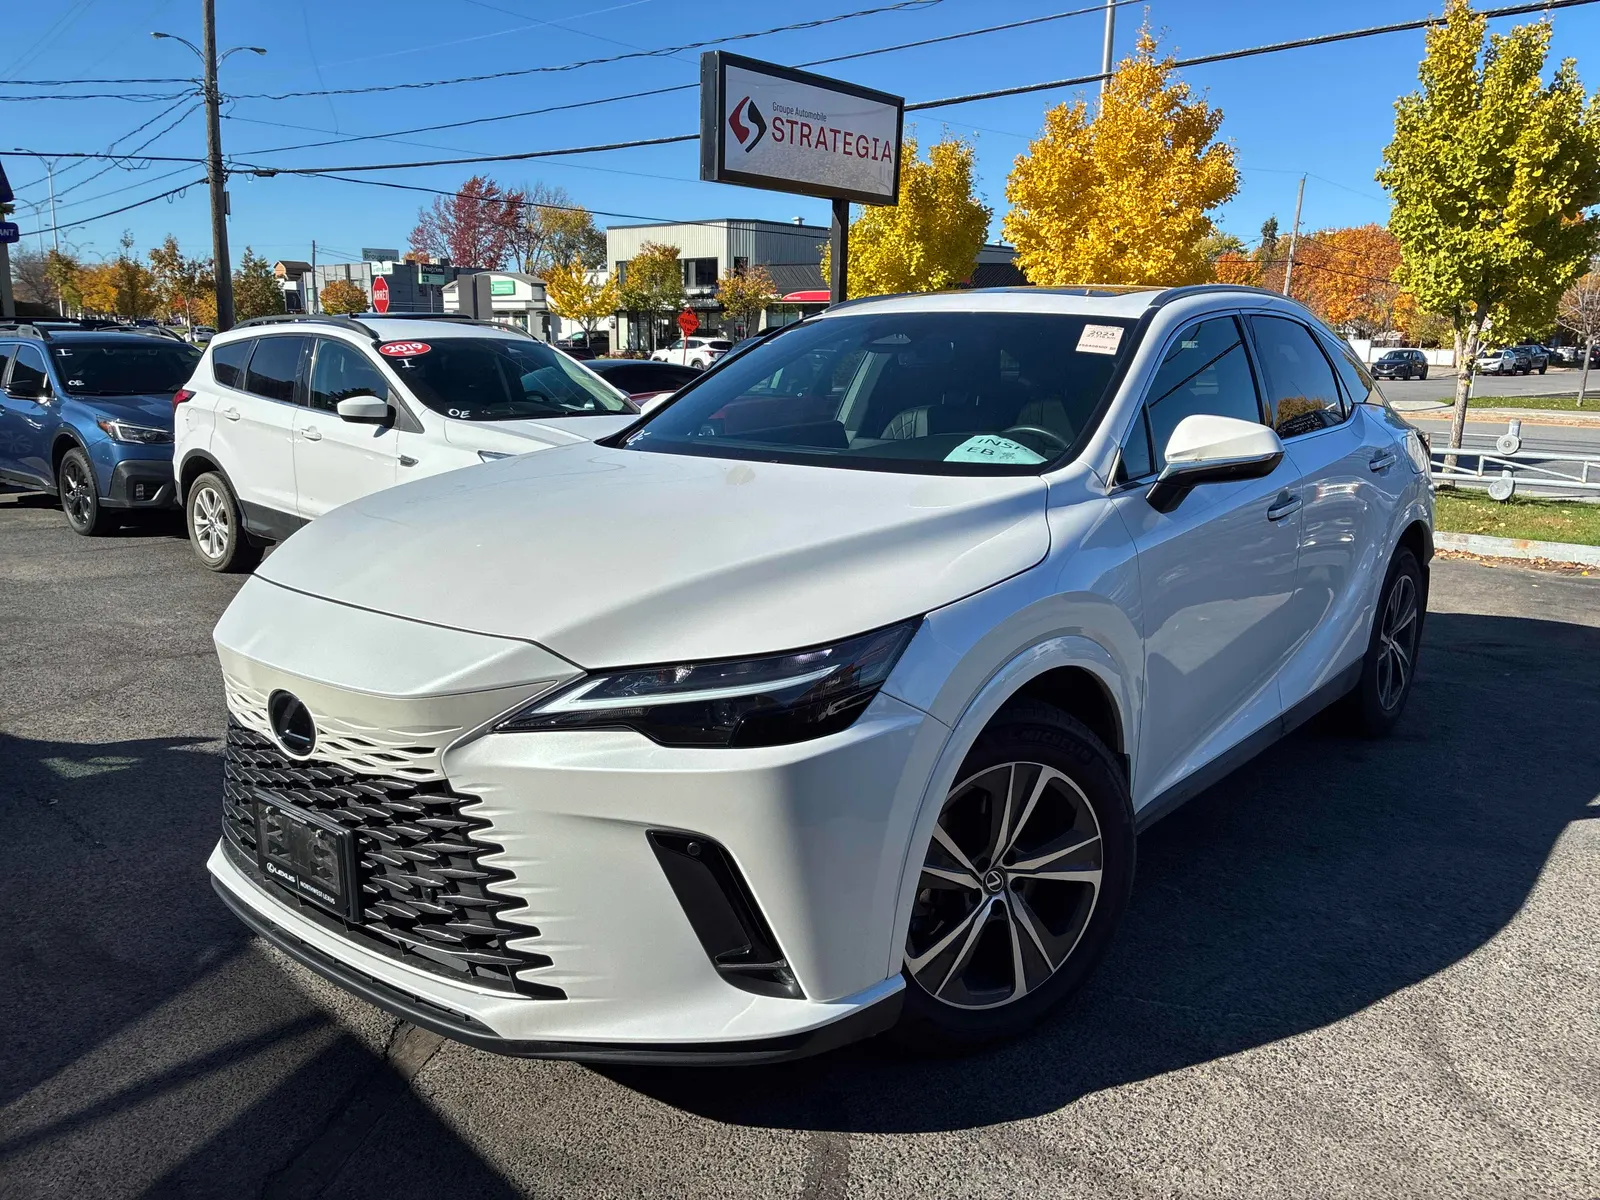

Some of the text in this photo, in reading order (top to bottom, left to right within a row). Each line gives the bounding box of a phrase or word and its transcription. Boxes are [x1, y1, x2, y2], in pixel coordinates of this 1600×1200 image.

[772, 101, 827, 122] Groupe Automobile
[771, 116, 893, 164] STRATEGIA
[374, 288, 388, 300] ARRÊT
[385, 343, 423, 353] 2019
[448, 408, 471, 419] OE
[967, 446, 995, 456] EB
[274, 867, 296, 883] LEXUS
